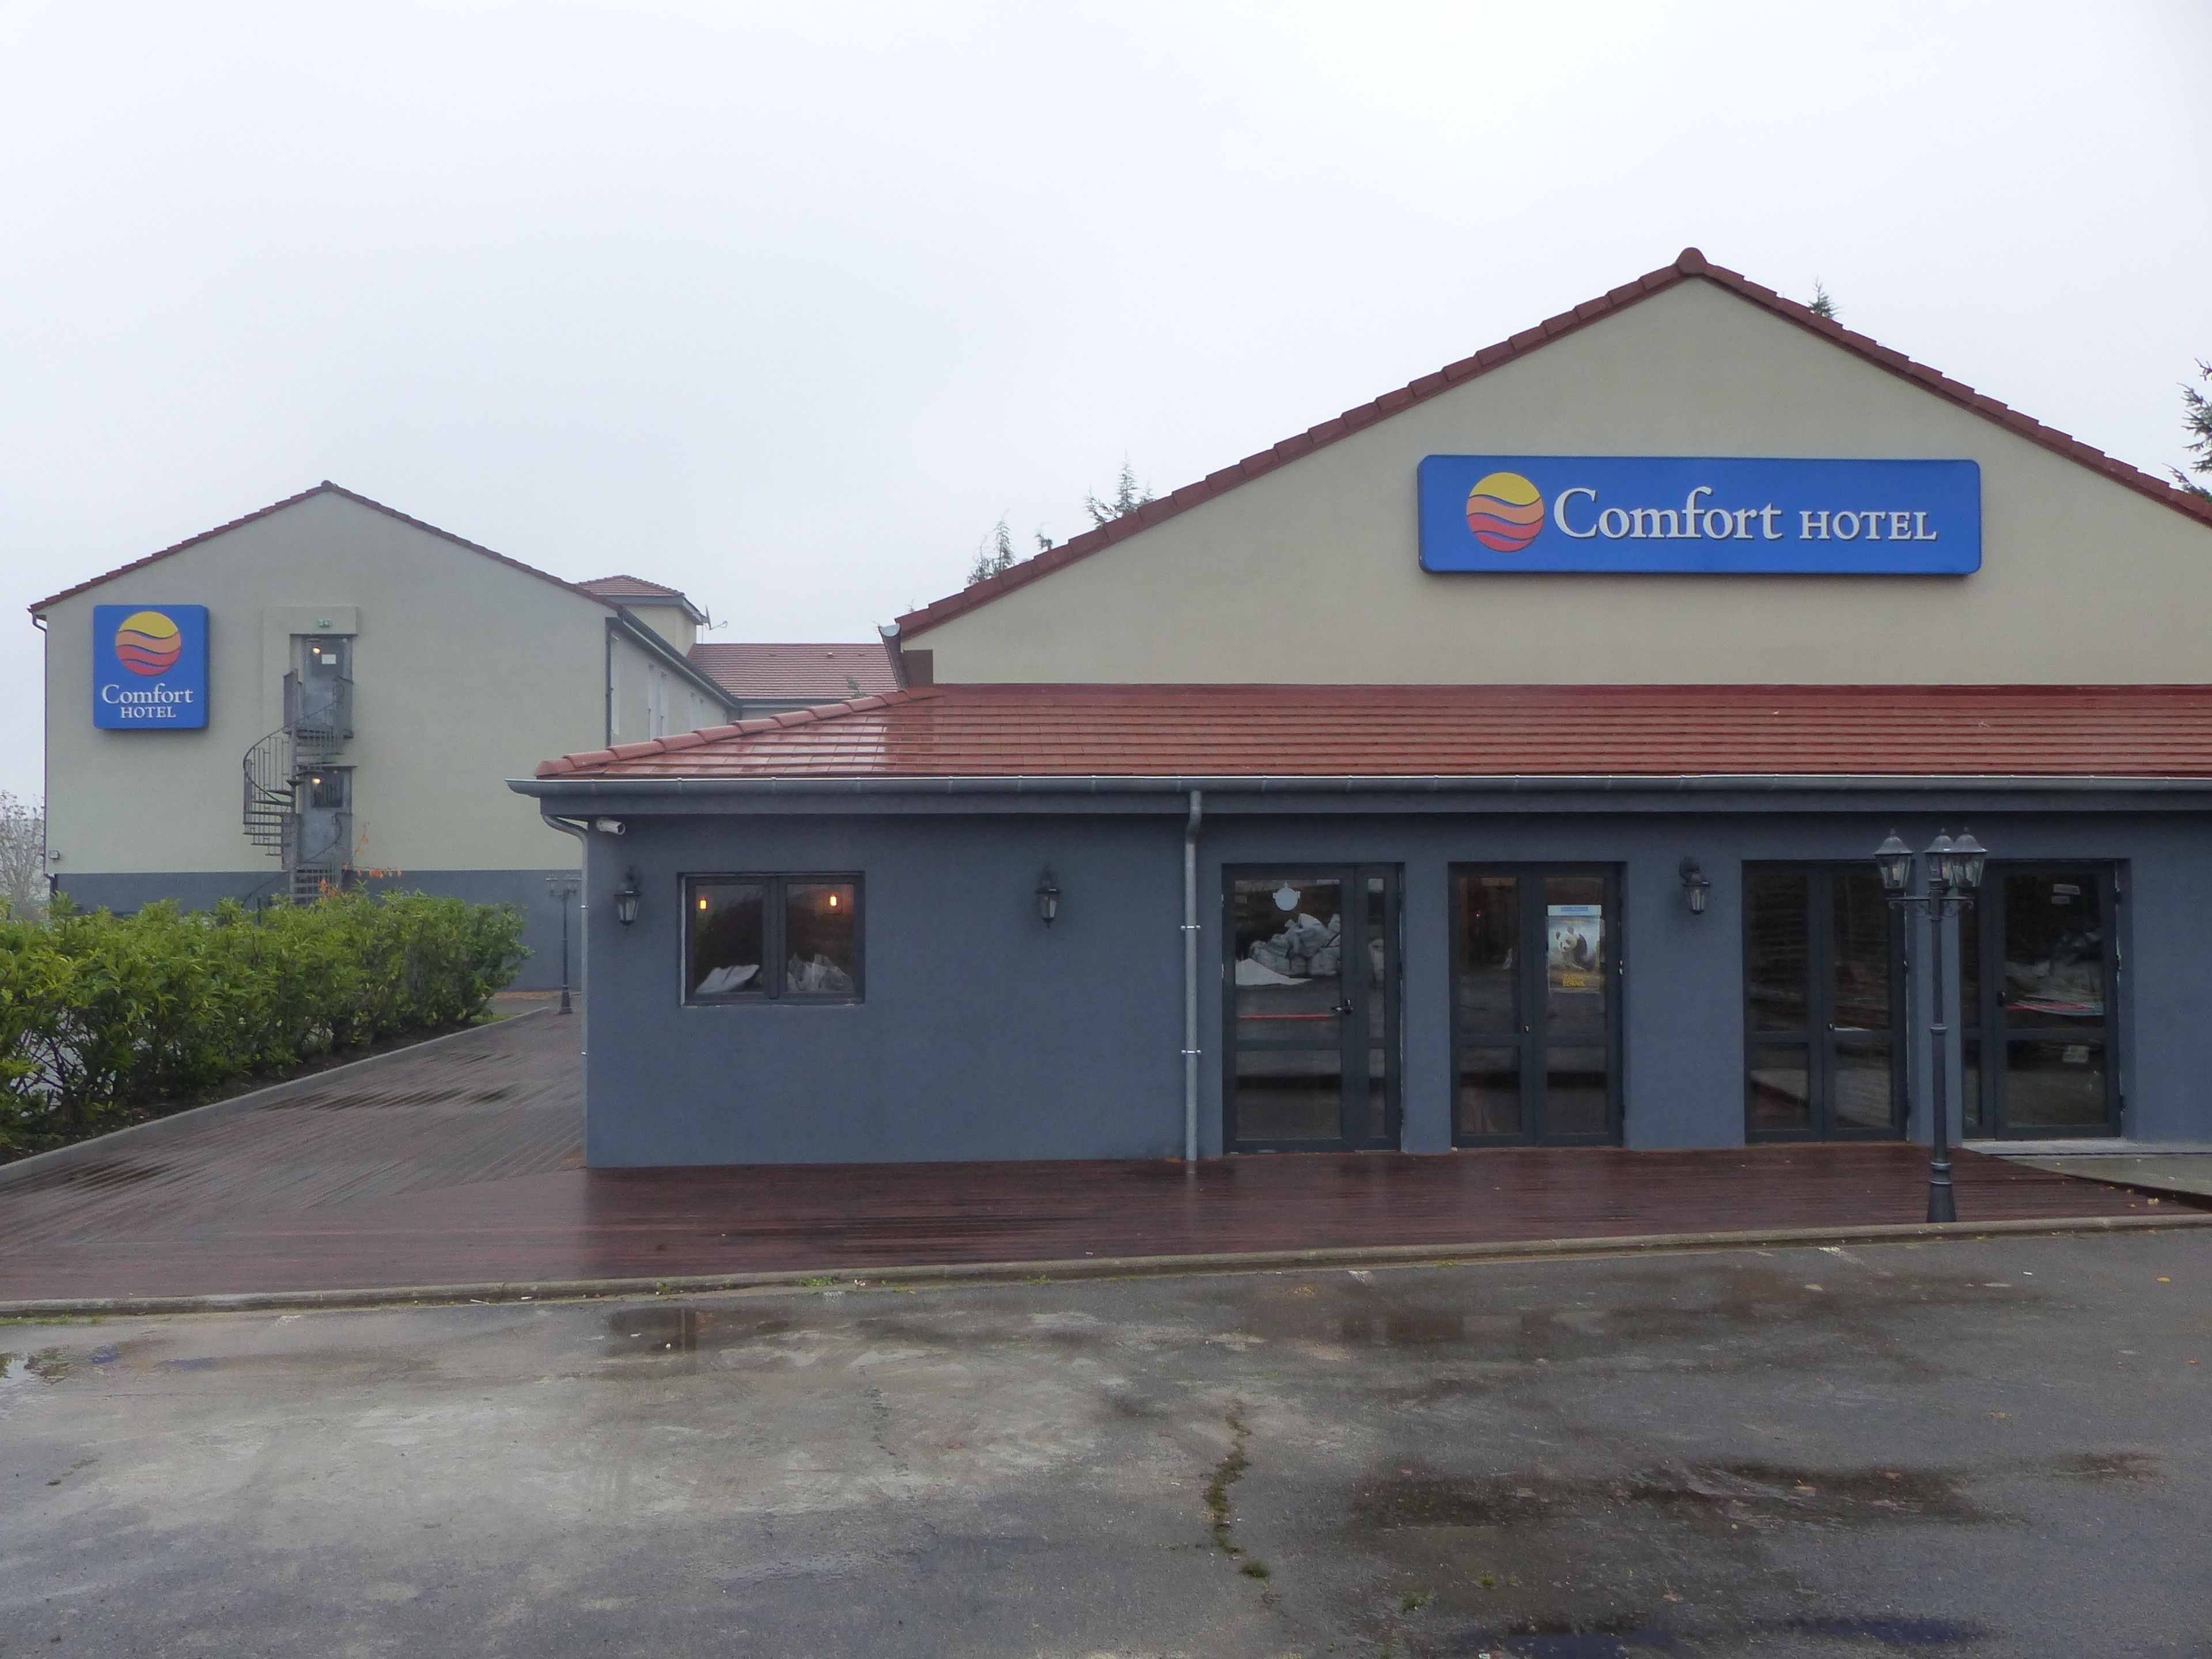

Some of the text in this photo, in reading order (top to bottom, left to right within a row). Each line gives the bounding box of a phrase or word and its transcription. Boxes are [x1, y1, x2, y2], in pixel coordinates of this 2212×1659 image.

[1554, 486, 1938, 540] Comfort HOTEL
[102, 683, 194, 704] Comfort
[120, 706, 176, 719] HOTEL
